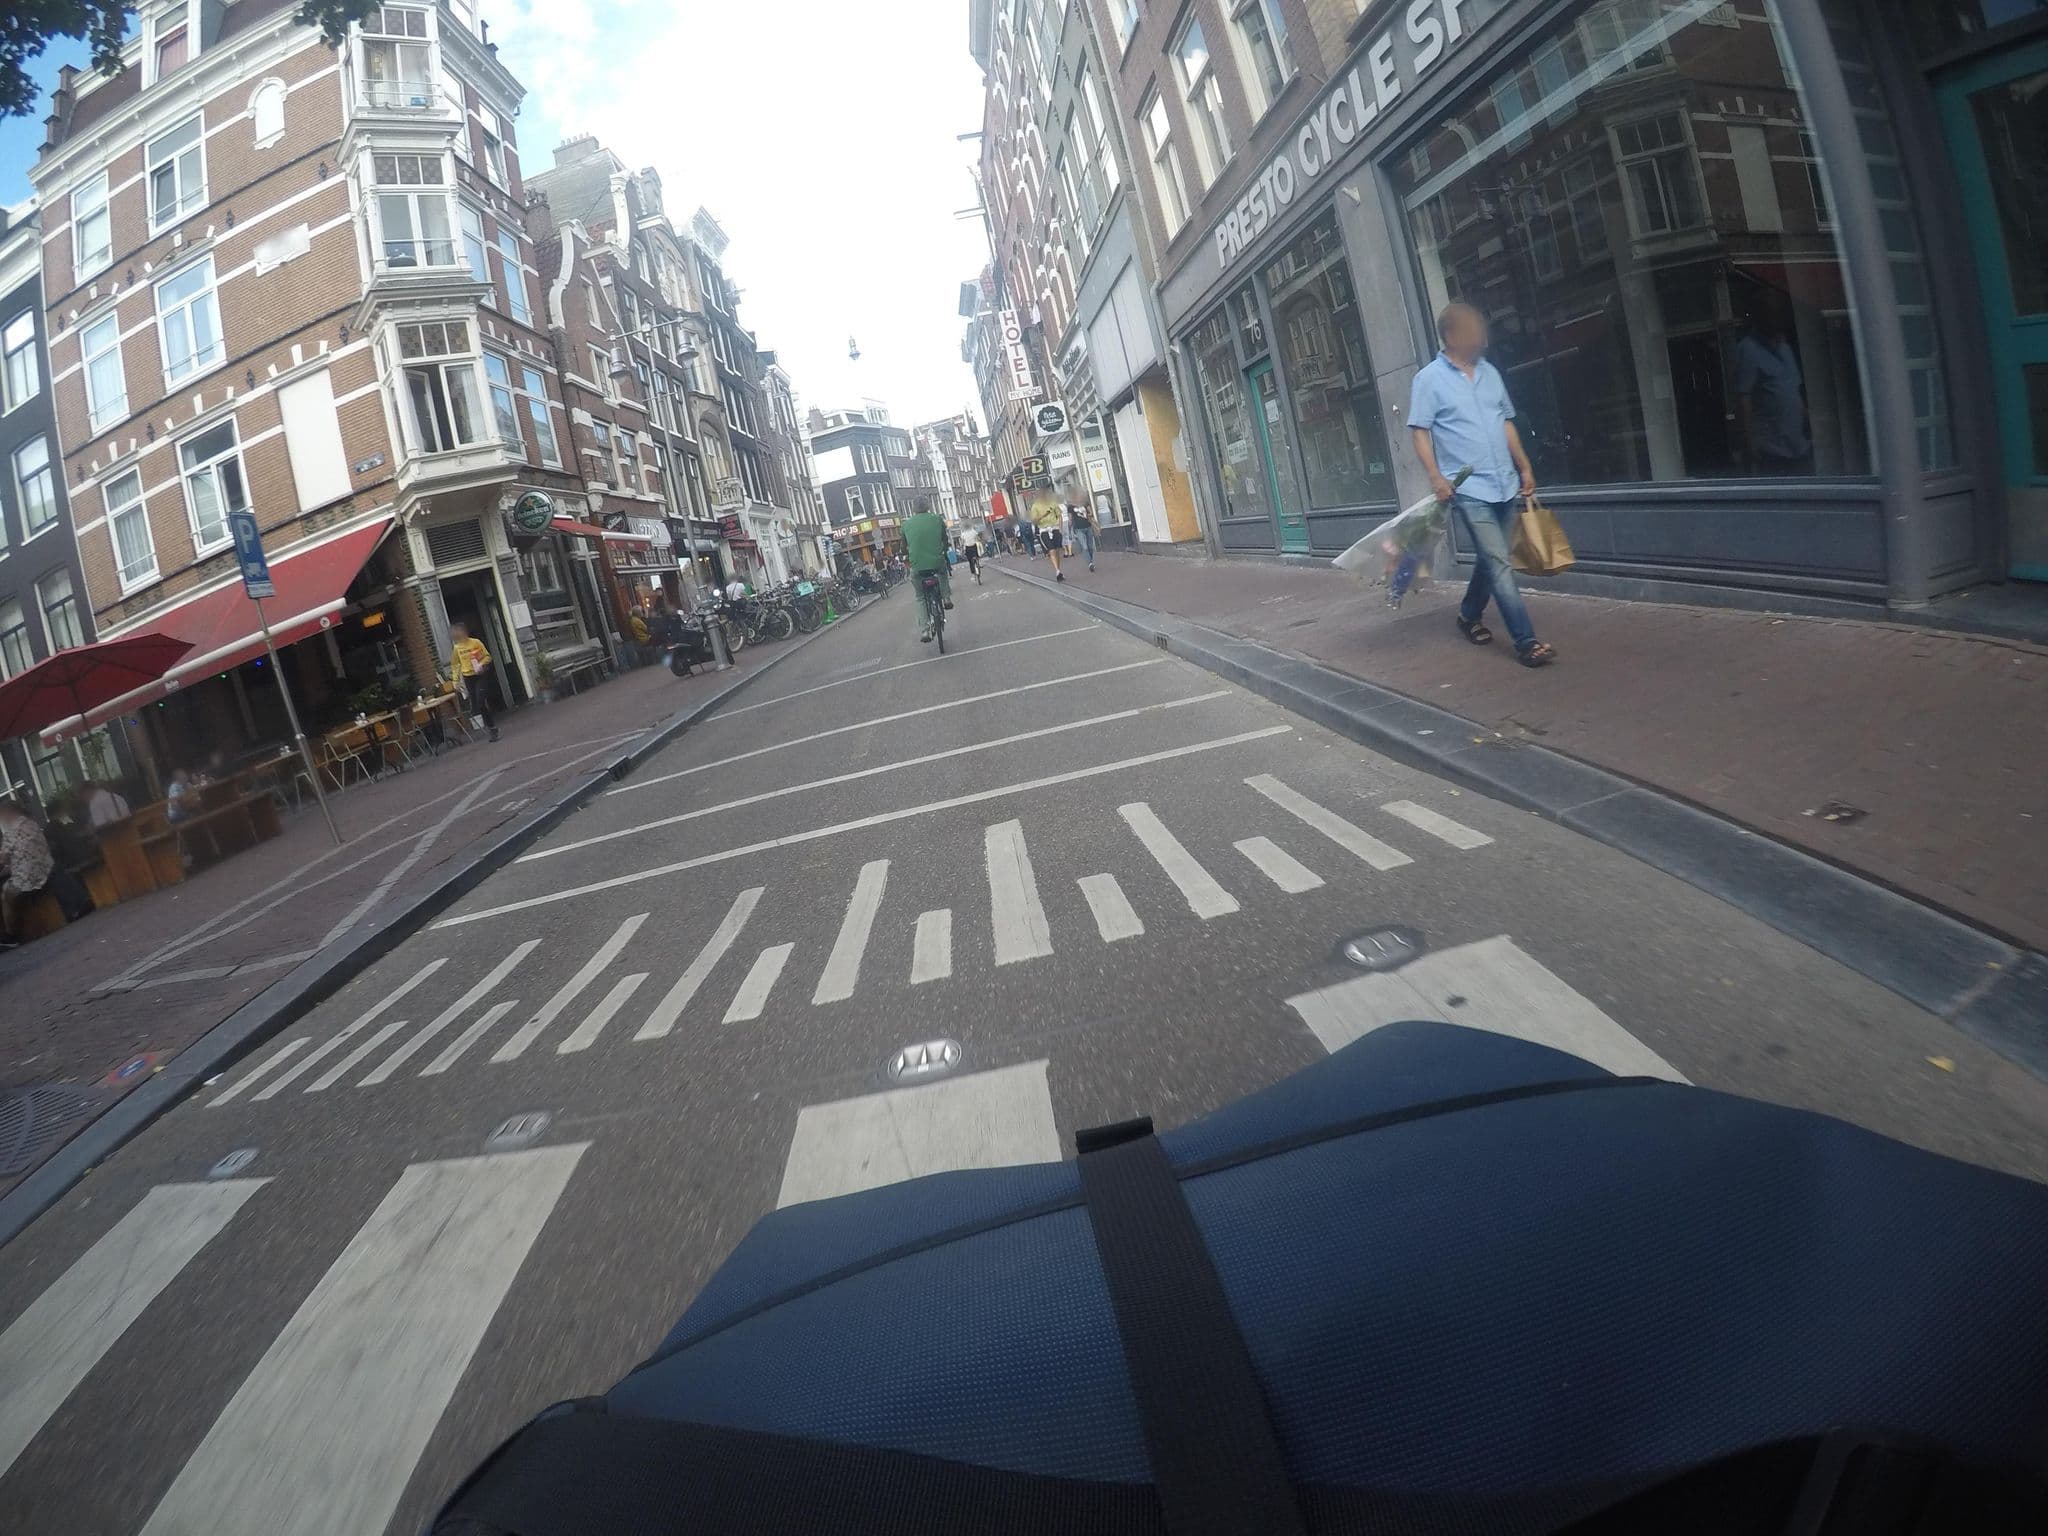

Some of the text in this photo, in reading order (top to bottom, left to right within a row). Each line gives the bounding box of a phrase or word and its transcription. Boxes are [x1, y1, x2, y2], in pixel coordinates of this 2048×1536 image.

[1215, 154, 1296, 268] PRESTO
[1298, 32, 1402, 178] CYCLE
[1249, 320, 1262, 345] 76
[1003, 311, 1030, 388] HOTEL
[1022, 388, 1042, 397] HOME
[1052, 451, 1071, 461] RAINS
